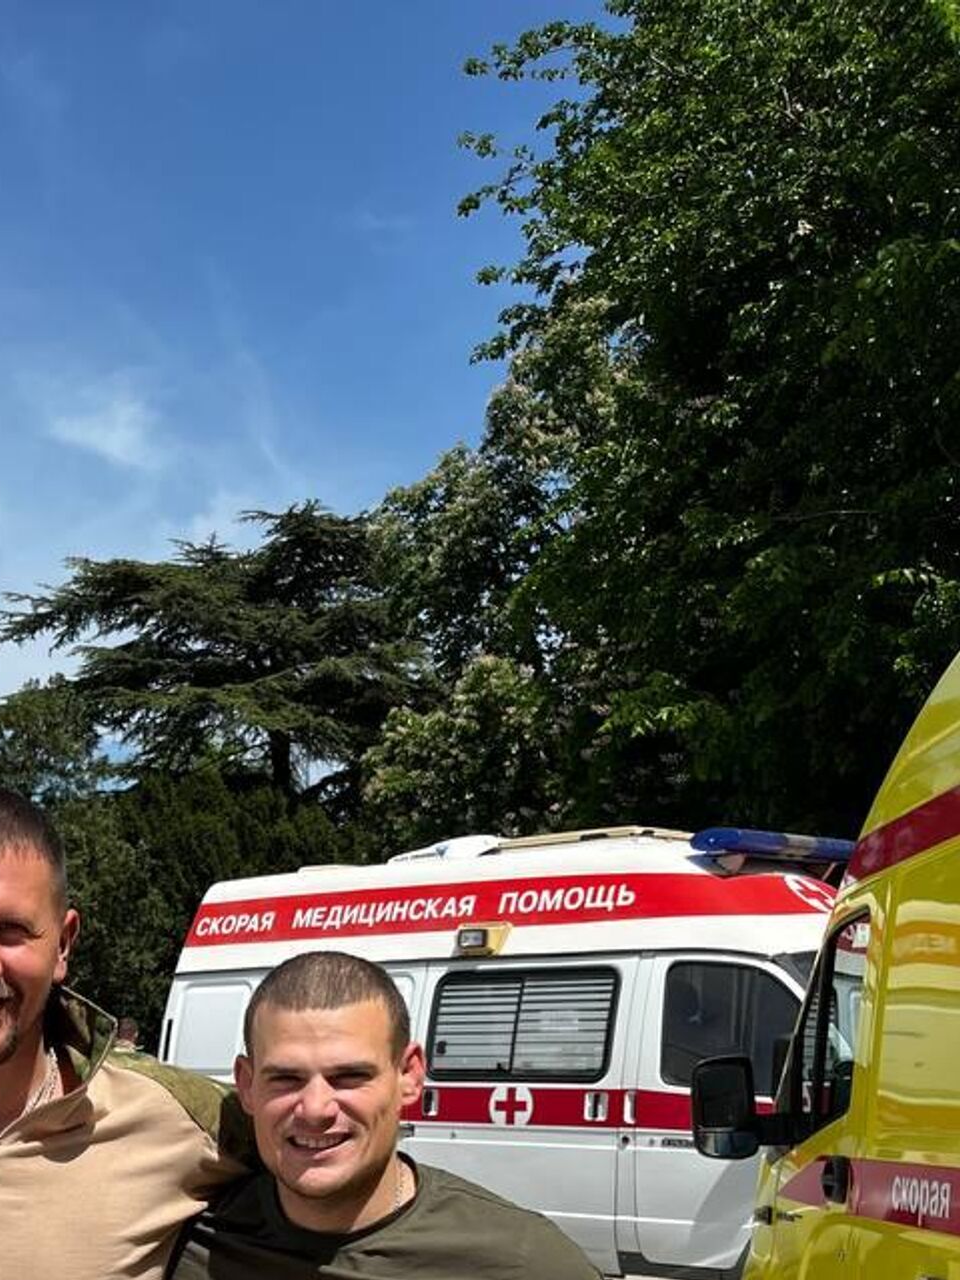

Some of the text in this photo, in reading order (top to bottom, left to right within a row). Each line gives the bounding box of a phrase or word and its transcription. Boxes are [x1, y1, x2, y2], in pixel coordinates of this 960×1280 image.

[195, 883, 636, 937] СКОРАЯ МЕДИЦИНСКАЯ ПОМОЩЬ
[891, 1176, 952, 1228] скорая
